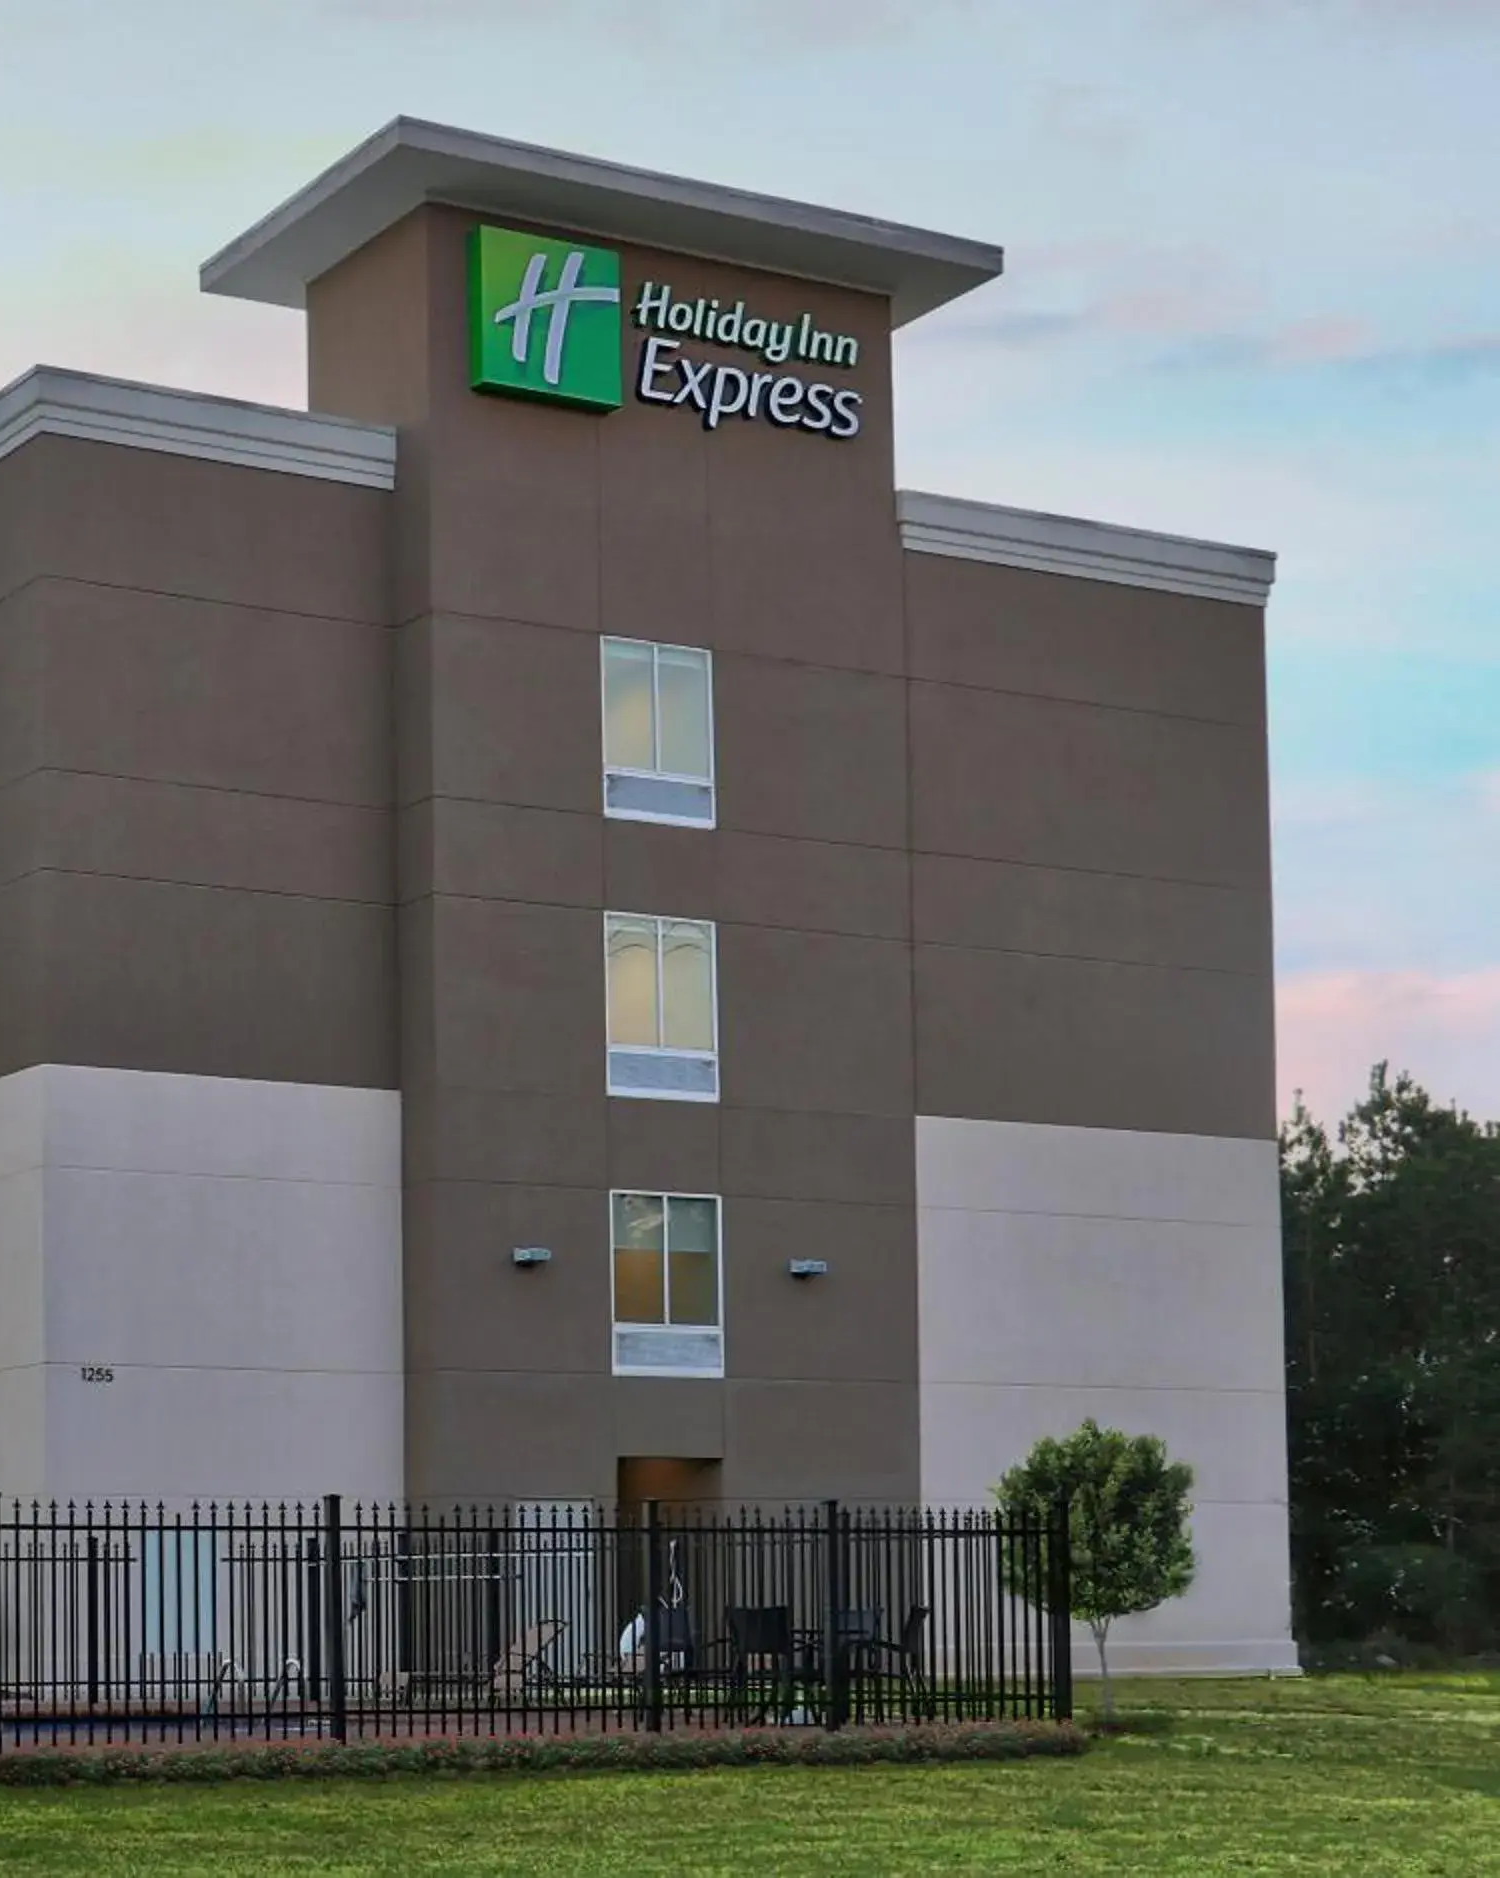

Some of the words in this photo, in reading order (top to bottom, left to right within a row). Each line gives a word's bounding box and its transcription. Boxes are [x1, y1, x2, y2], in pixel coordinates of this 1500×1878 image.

[493, 251, 619, 384] H
[637, 281, 793, 362] Holiday
[799, 312, 858, 366] Inn
[640, 337, 863, 438] Express
[81, 1367, 114, 1382] 1255
